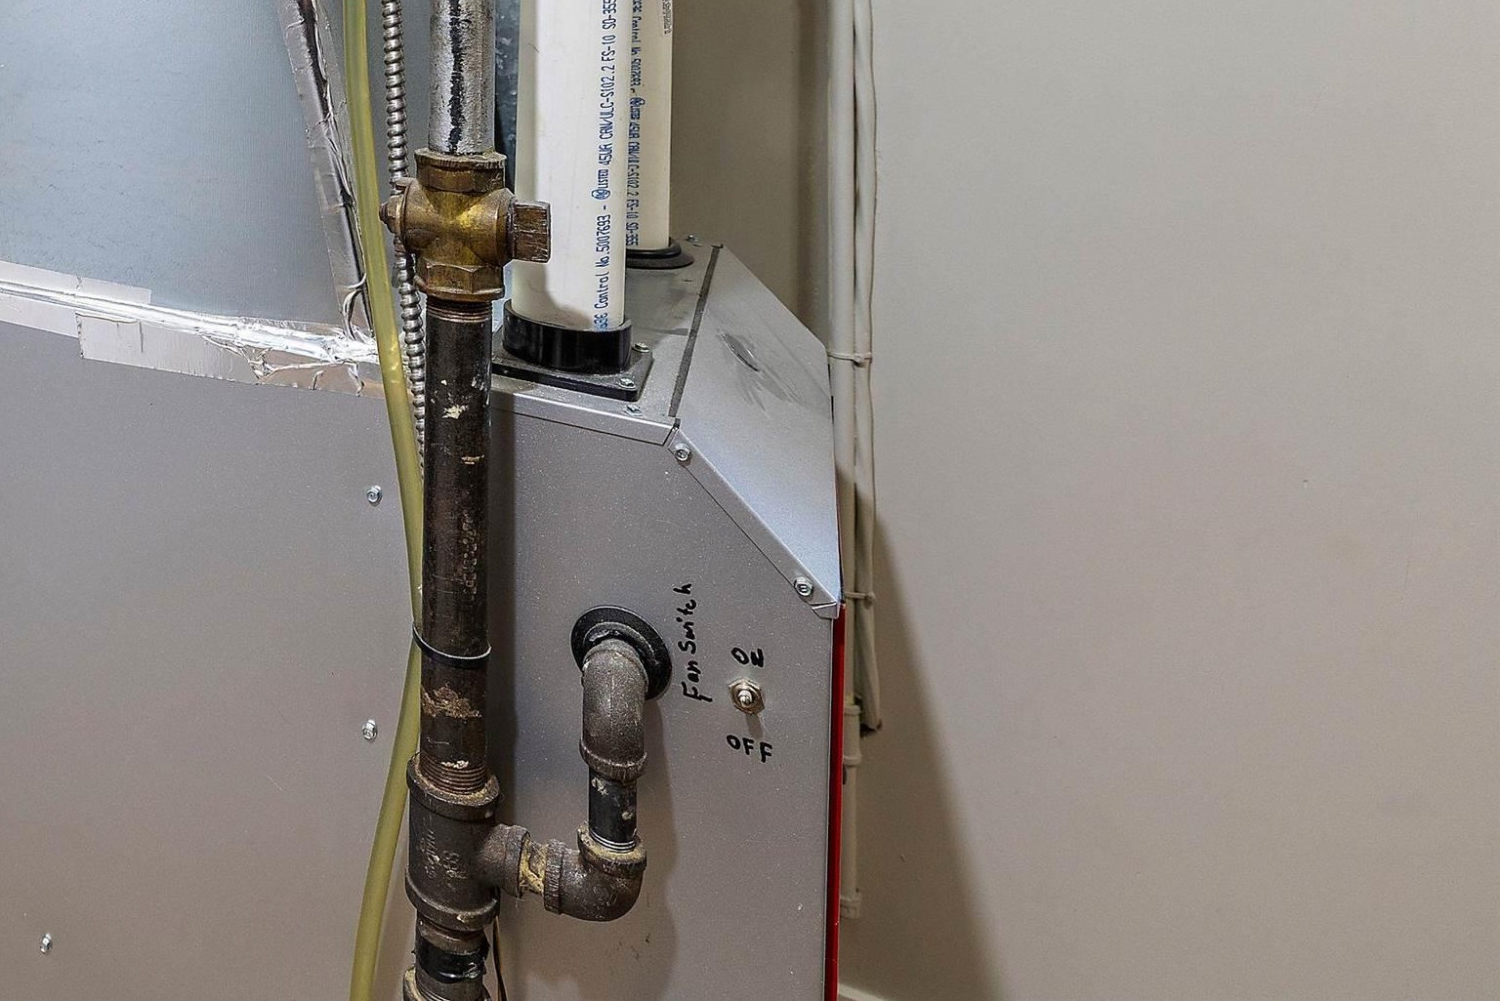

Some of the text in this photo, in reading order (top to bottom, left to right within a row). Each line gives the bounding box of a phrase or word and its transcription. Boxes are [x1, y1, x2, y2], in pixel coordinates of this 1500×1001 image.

[601, 35, 616, 62] FS-10
[598, 168, 609, 189] LISTED
[626, 199, 639, 219] FS-10
[625, 222, 639, 246] SD-355
[594, 272, 610, 309] Control
[672, 583, 713, 703] Fan Switch
[730, 647, 765, 669] ON
[726, 734, 773, 763] OFF
